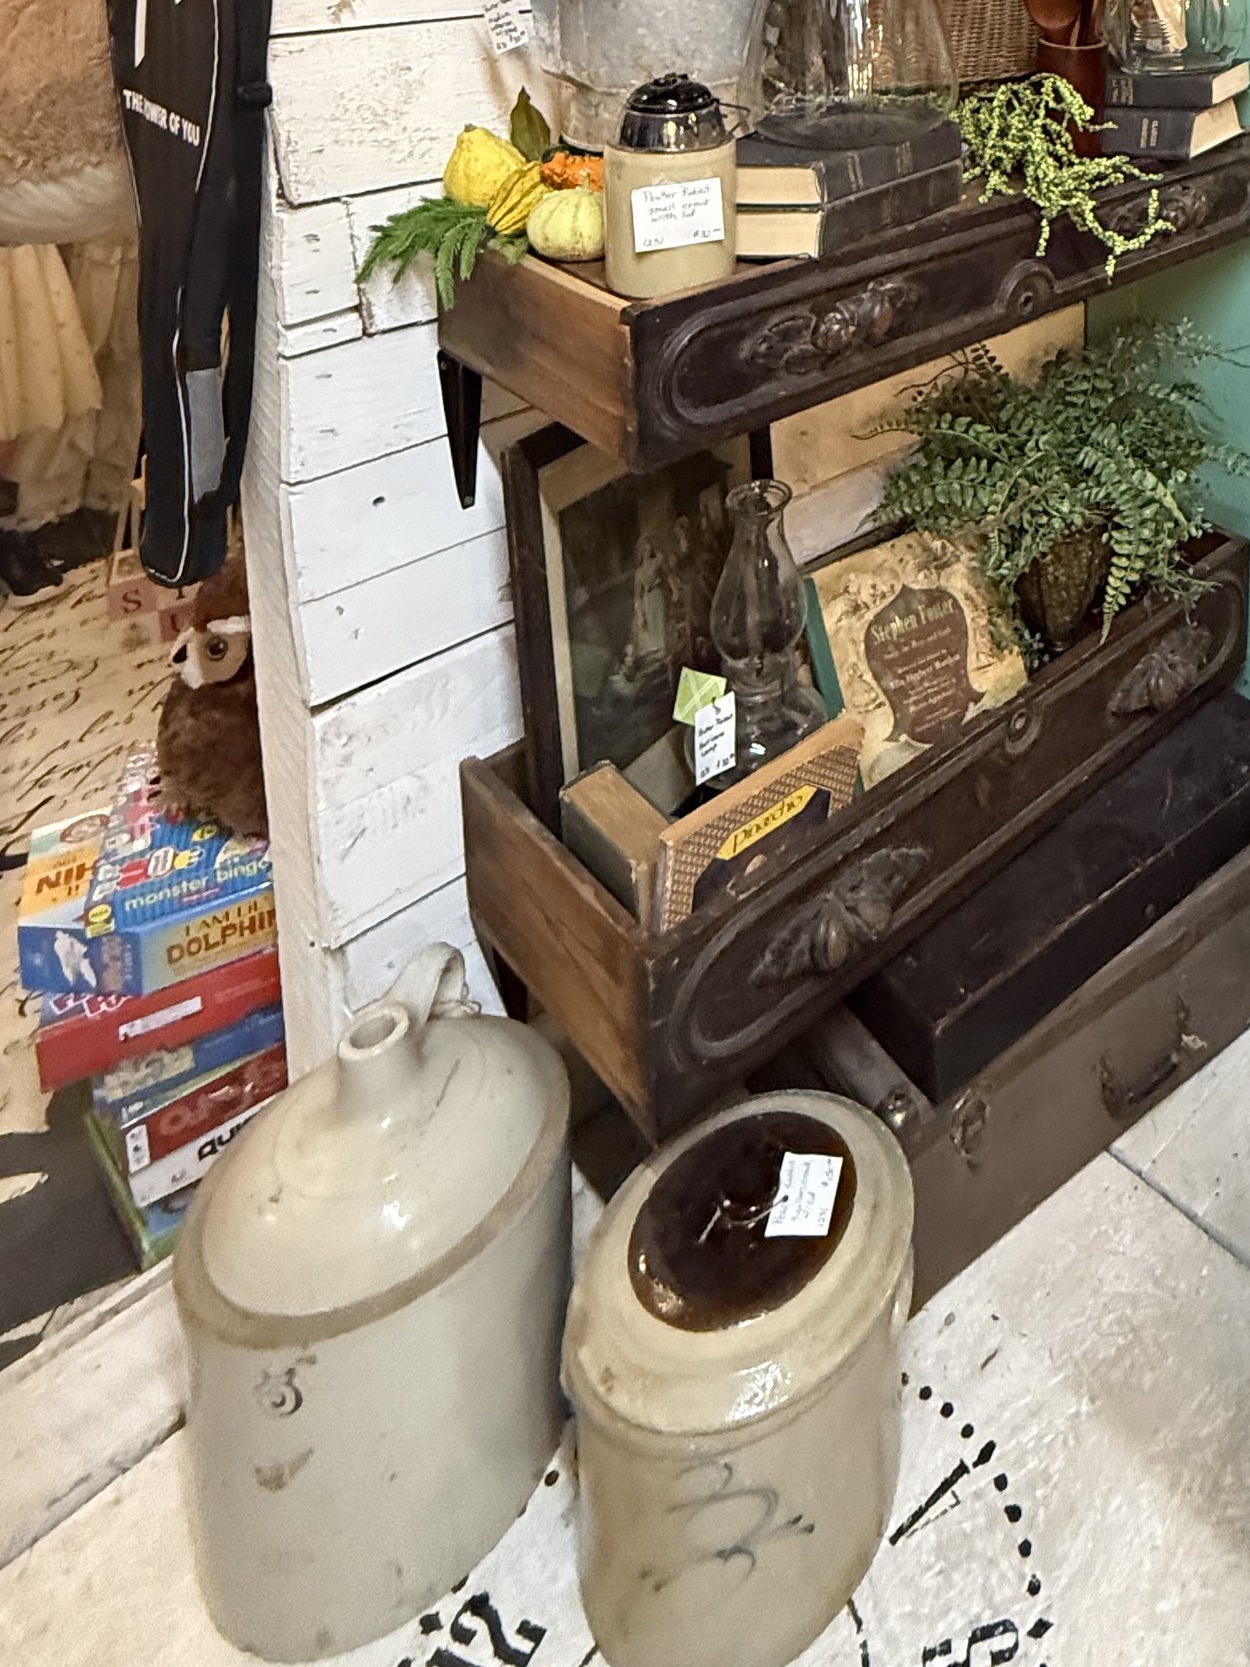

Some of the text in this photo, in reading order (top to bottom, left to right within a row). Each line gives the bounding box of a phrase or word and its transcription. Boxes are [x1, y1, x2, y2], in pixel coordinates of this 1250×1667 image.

[122, 88, 143, 114] THE
[181, 117, 201, 148] YOU
[869, 612, 918, 646] Stephen
[125, 875, 209, 912] monster
[215, 856, 269, 883] bingo
[200, 910, 229, 929] AM
